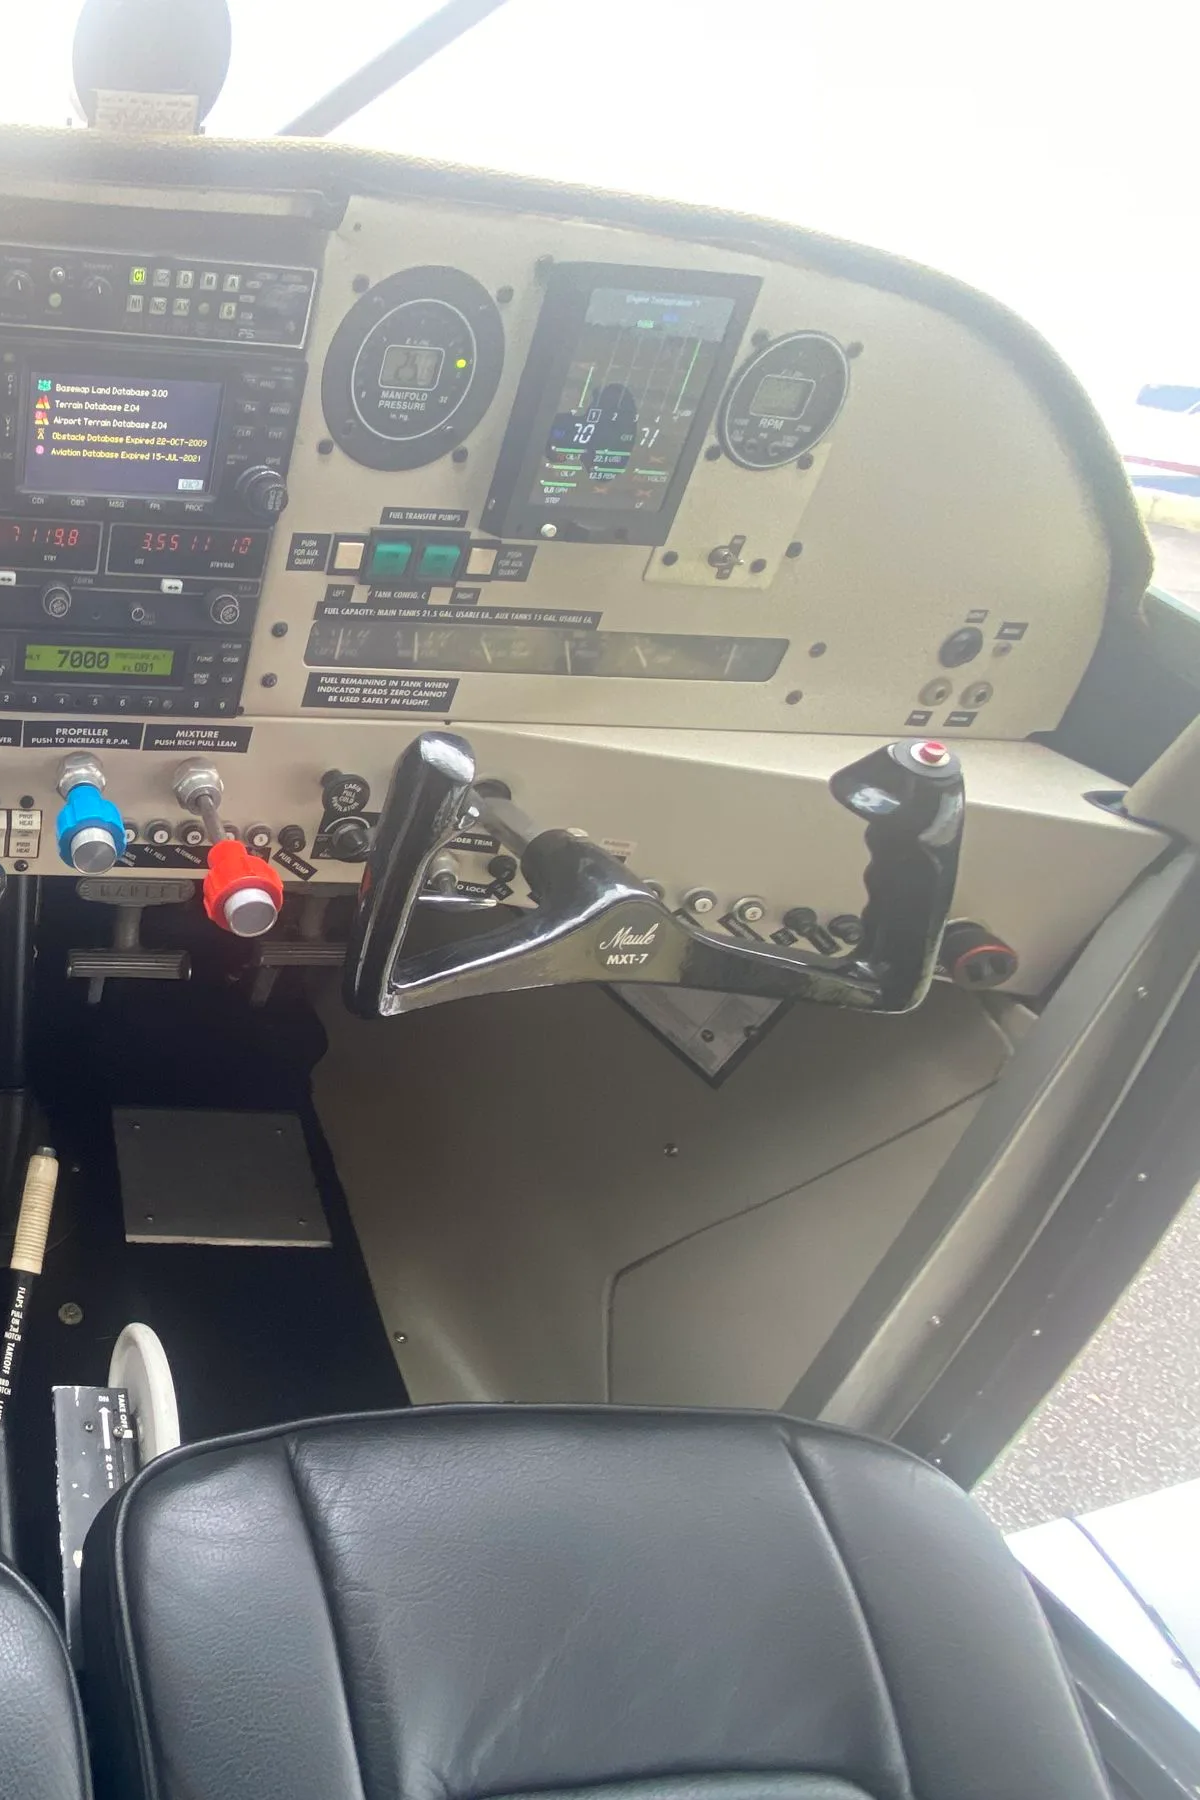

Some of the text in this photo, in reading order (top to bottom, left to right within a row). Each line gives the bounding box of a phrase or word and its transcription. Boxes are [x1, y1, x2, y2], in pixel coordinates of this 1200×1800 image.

[55, 383, 168, 398] Basemap Land Database 3.00
[380, 391, 428, 401] MANIFOLD
[55, 400, 140, 412] Terrain Database 2.04
[378, 400, 426, 411] PRESSURE
[53, 416, 168, 430] Airport Terrain Database 2.04
[759, 417, 784, 431] RPM
[52, 432, 85, 442] Obstacle
[86, 433, 124, 444] Database
[125, 435, 155, 445] Expired
[51, 447, 81, 457] Aviation
[82, 449, 119, 459] Database
[120, 451, 150, 461] Expired
[388, 512, 461, 522] FUEL TRANSFER PUMPS
[57, 649, 110, 669] 7000
[320, 676, 338, 684] FUEL
[340, 677, 387, 687] REMAINING
[400, 680, 421, 688] TANK
[424, 681, 450, 689] WHEN
[317, 686, 447, 698] INDICATOR READS ZERO CANNOT
[361, 697, 389, 705] SAFELY
[390, 698, 400, 706] IN
[401, 699, 430, 707] FLIGHT.
[55, 728, 109, 737] PROPELLER
[175, 730, 220, 739] MIXTURE
[31, 737, 53, 745] PUSH
[154, 739, 176, 747] PUSH
[216, 740, 238, 748] LEAN
[473, 839, 493, 848] TRIM
[278, 852, 310, 875] FUEL PUMP
[465, 885, 487, 894] LOCK
[600, 923, 659, 950] Maule
[606, 953, 649, 965] MXT-7
[14, 1287, 26, 1309] FLAPS
[4, 1331, 22, 1342] NOTCH
[1, 1342, 16, 1375] TAKEOFF
[117, 1393, 129, 1429] TAKE OFF
